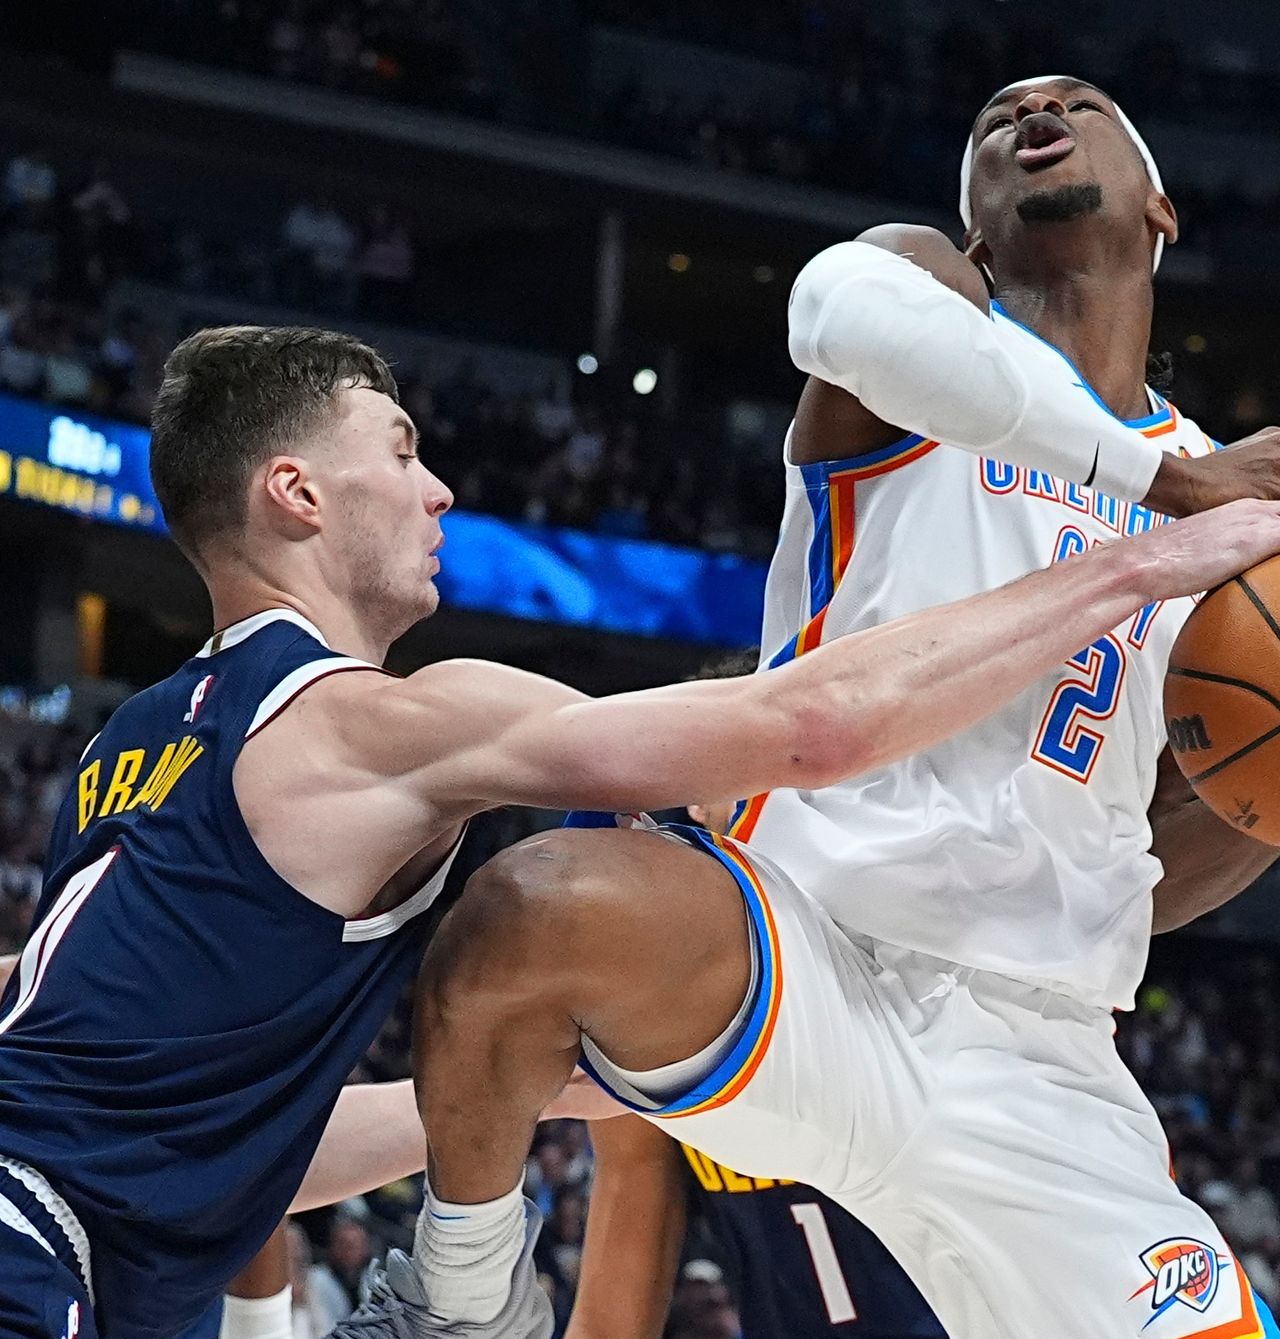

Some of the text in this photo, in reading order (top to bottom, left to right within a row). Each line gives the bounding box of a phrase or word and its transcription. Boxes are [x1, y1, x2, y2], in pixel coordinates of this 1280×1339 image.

[1030, 631, 1126, 785] 2
[789, 1202, 858, 1325] 1
[1153, 1249, 1207, 1305] OKC
